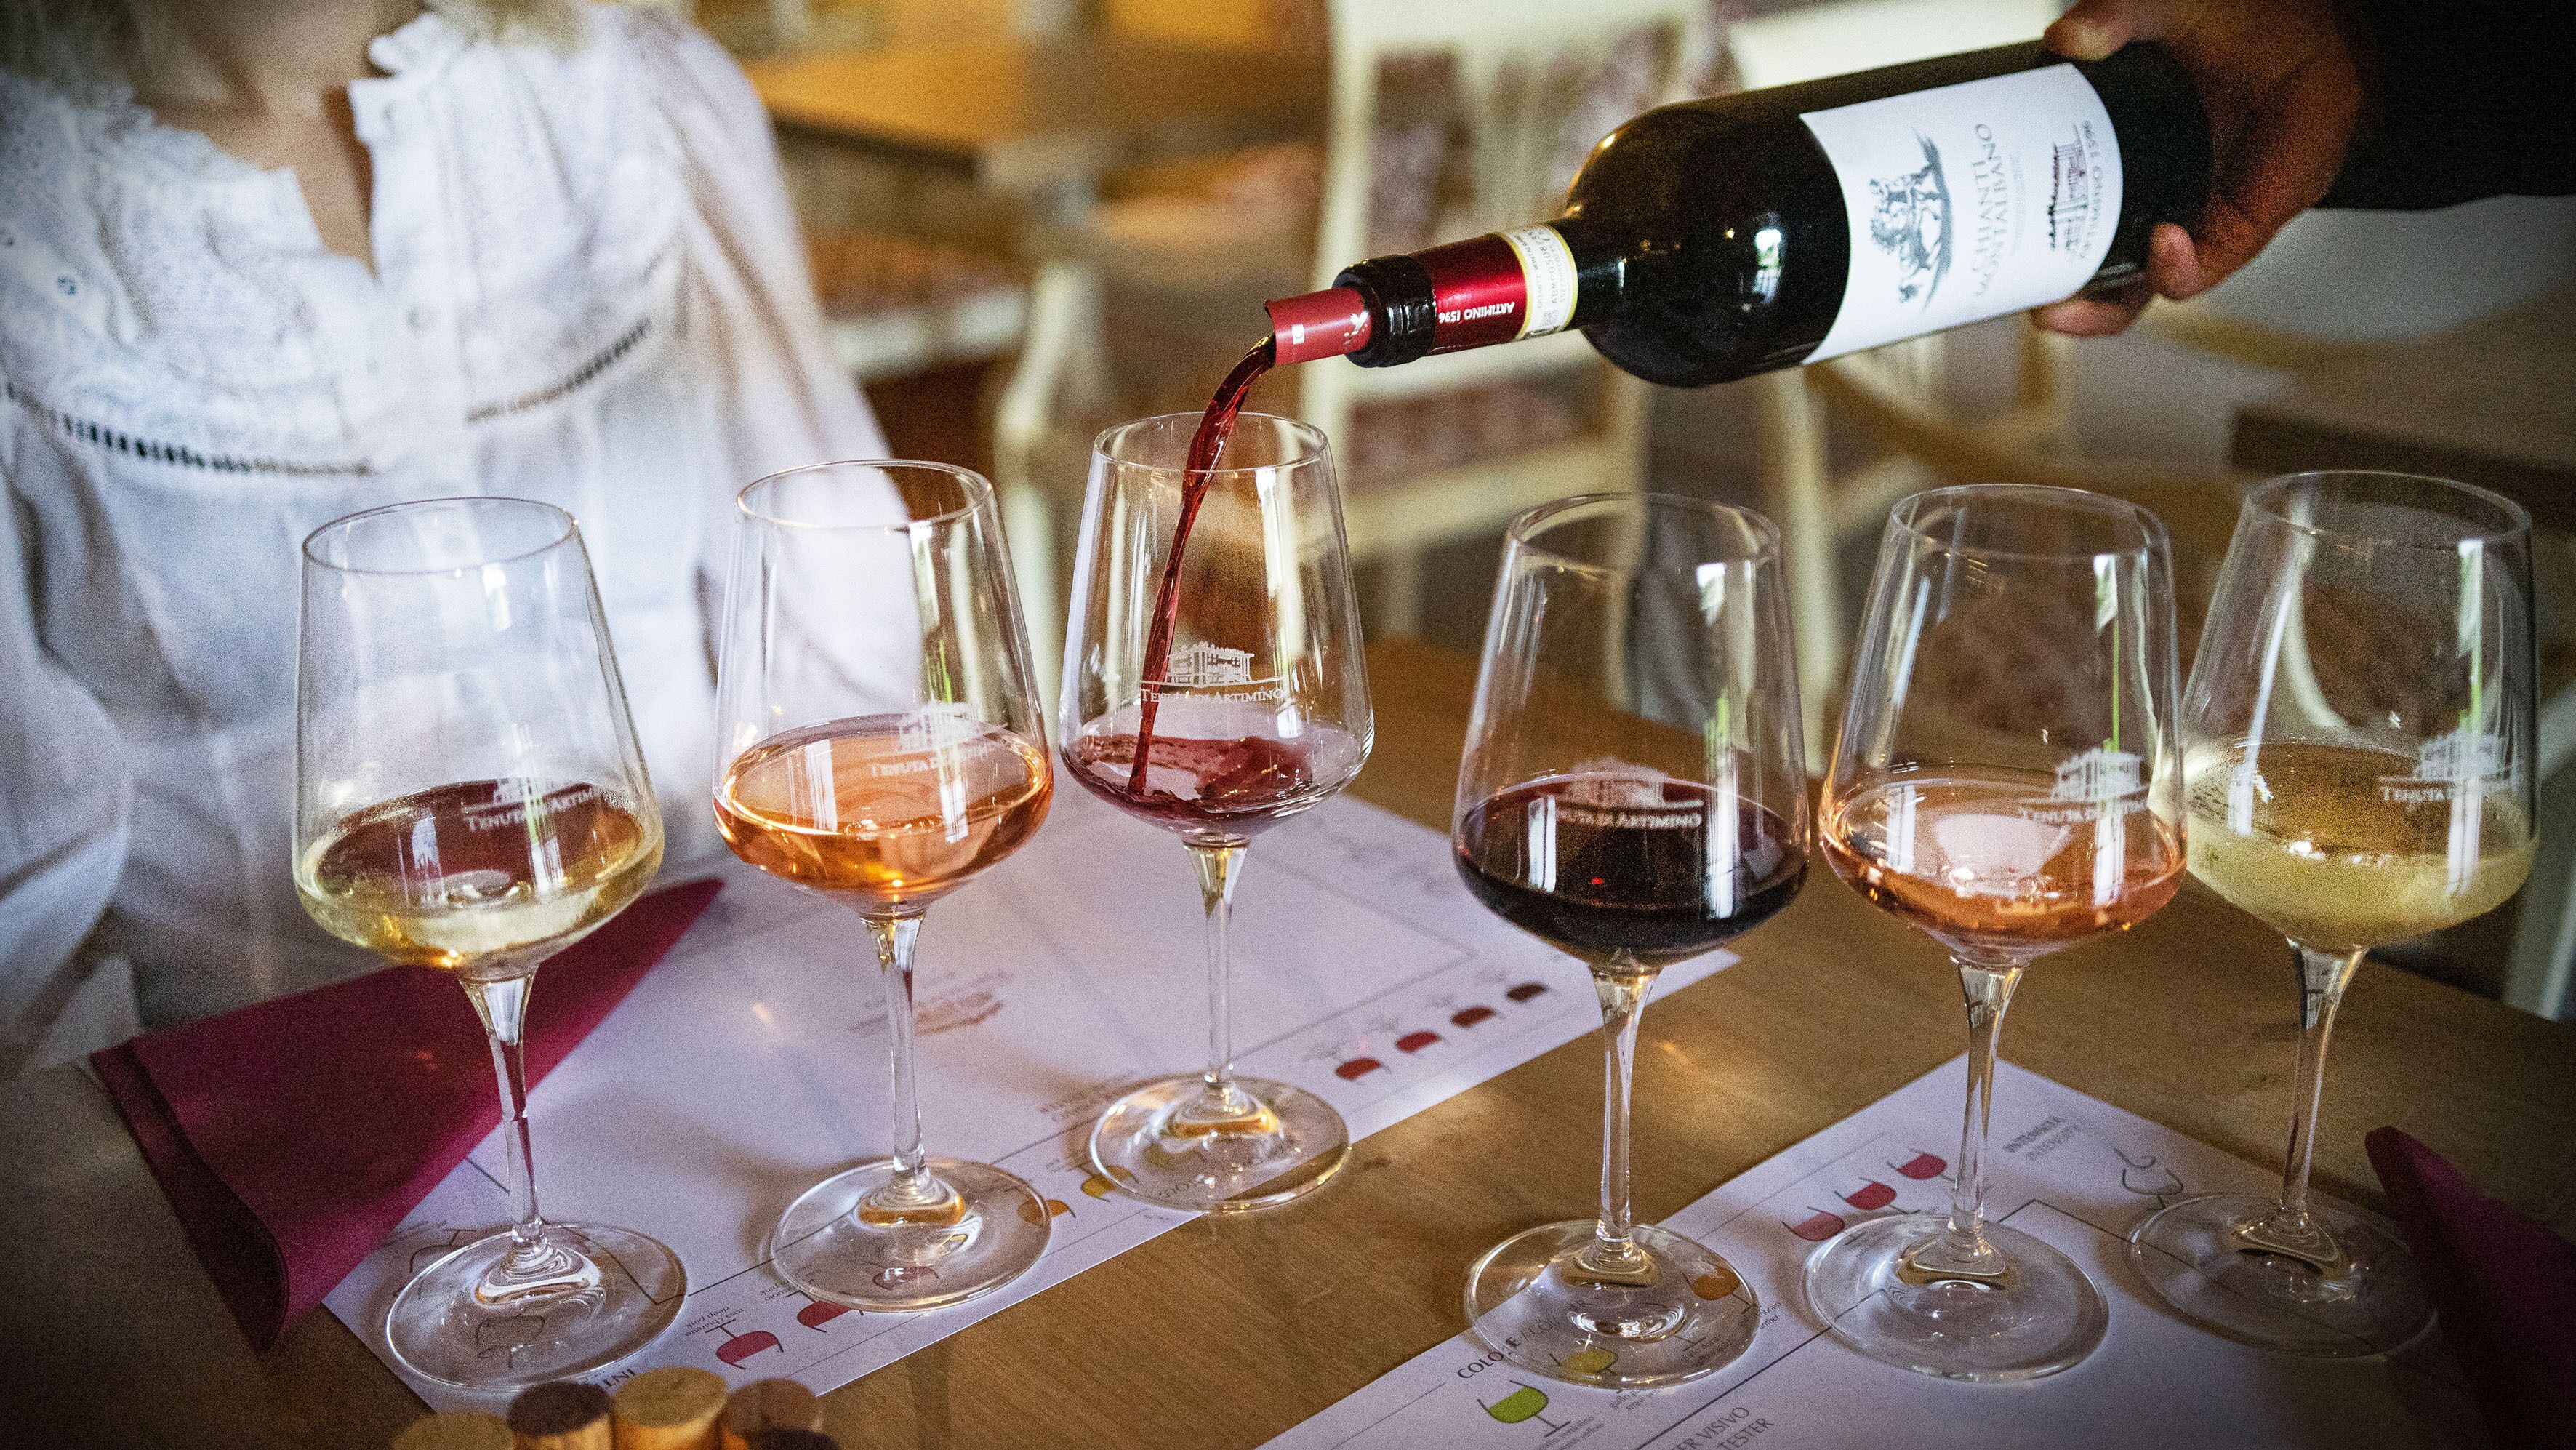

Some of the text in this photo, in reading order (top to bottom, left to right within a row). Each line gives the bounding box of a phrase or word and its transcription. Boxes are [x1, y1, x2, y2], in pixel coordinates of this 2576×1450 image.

[1438, 302, 1515, 324] ARTIMINO 1596
[1211, 688, 1285, 705] ARTIMINO
[2380, 785, 2445, 801] TENUTA
[1616, 810, 1703, 830] ARTIMINO
[684, 1308, 745, 1337] rosa chiaretto
[686, 1306, 729, 1329] deep pink
[1695, 1406, 1750, 1440] VISIVO
[1716, 1417, 1775, 1450] TESTER
